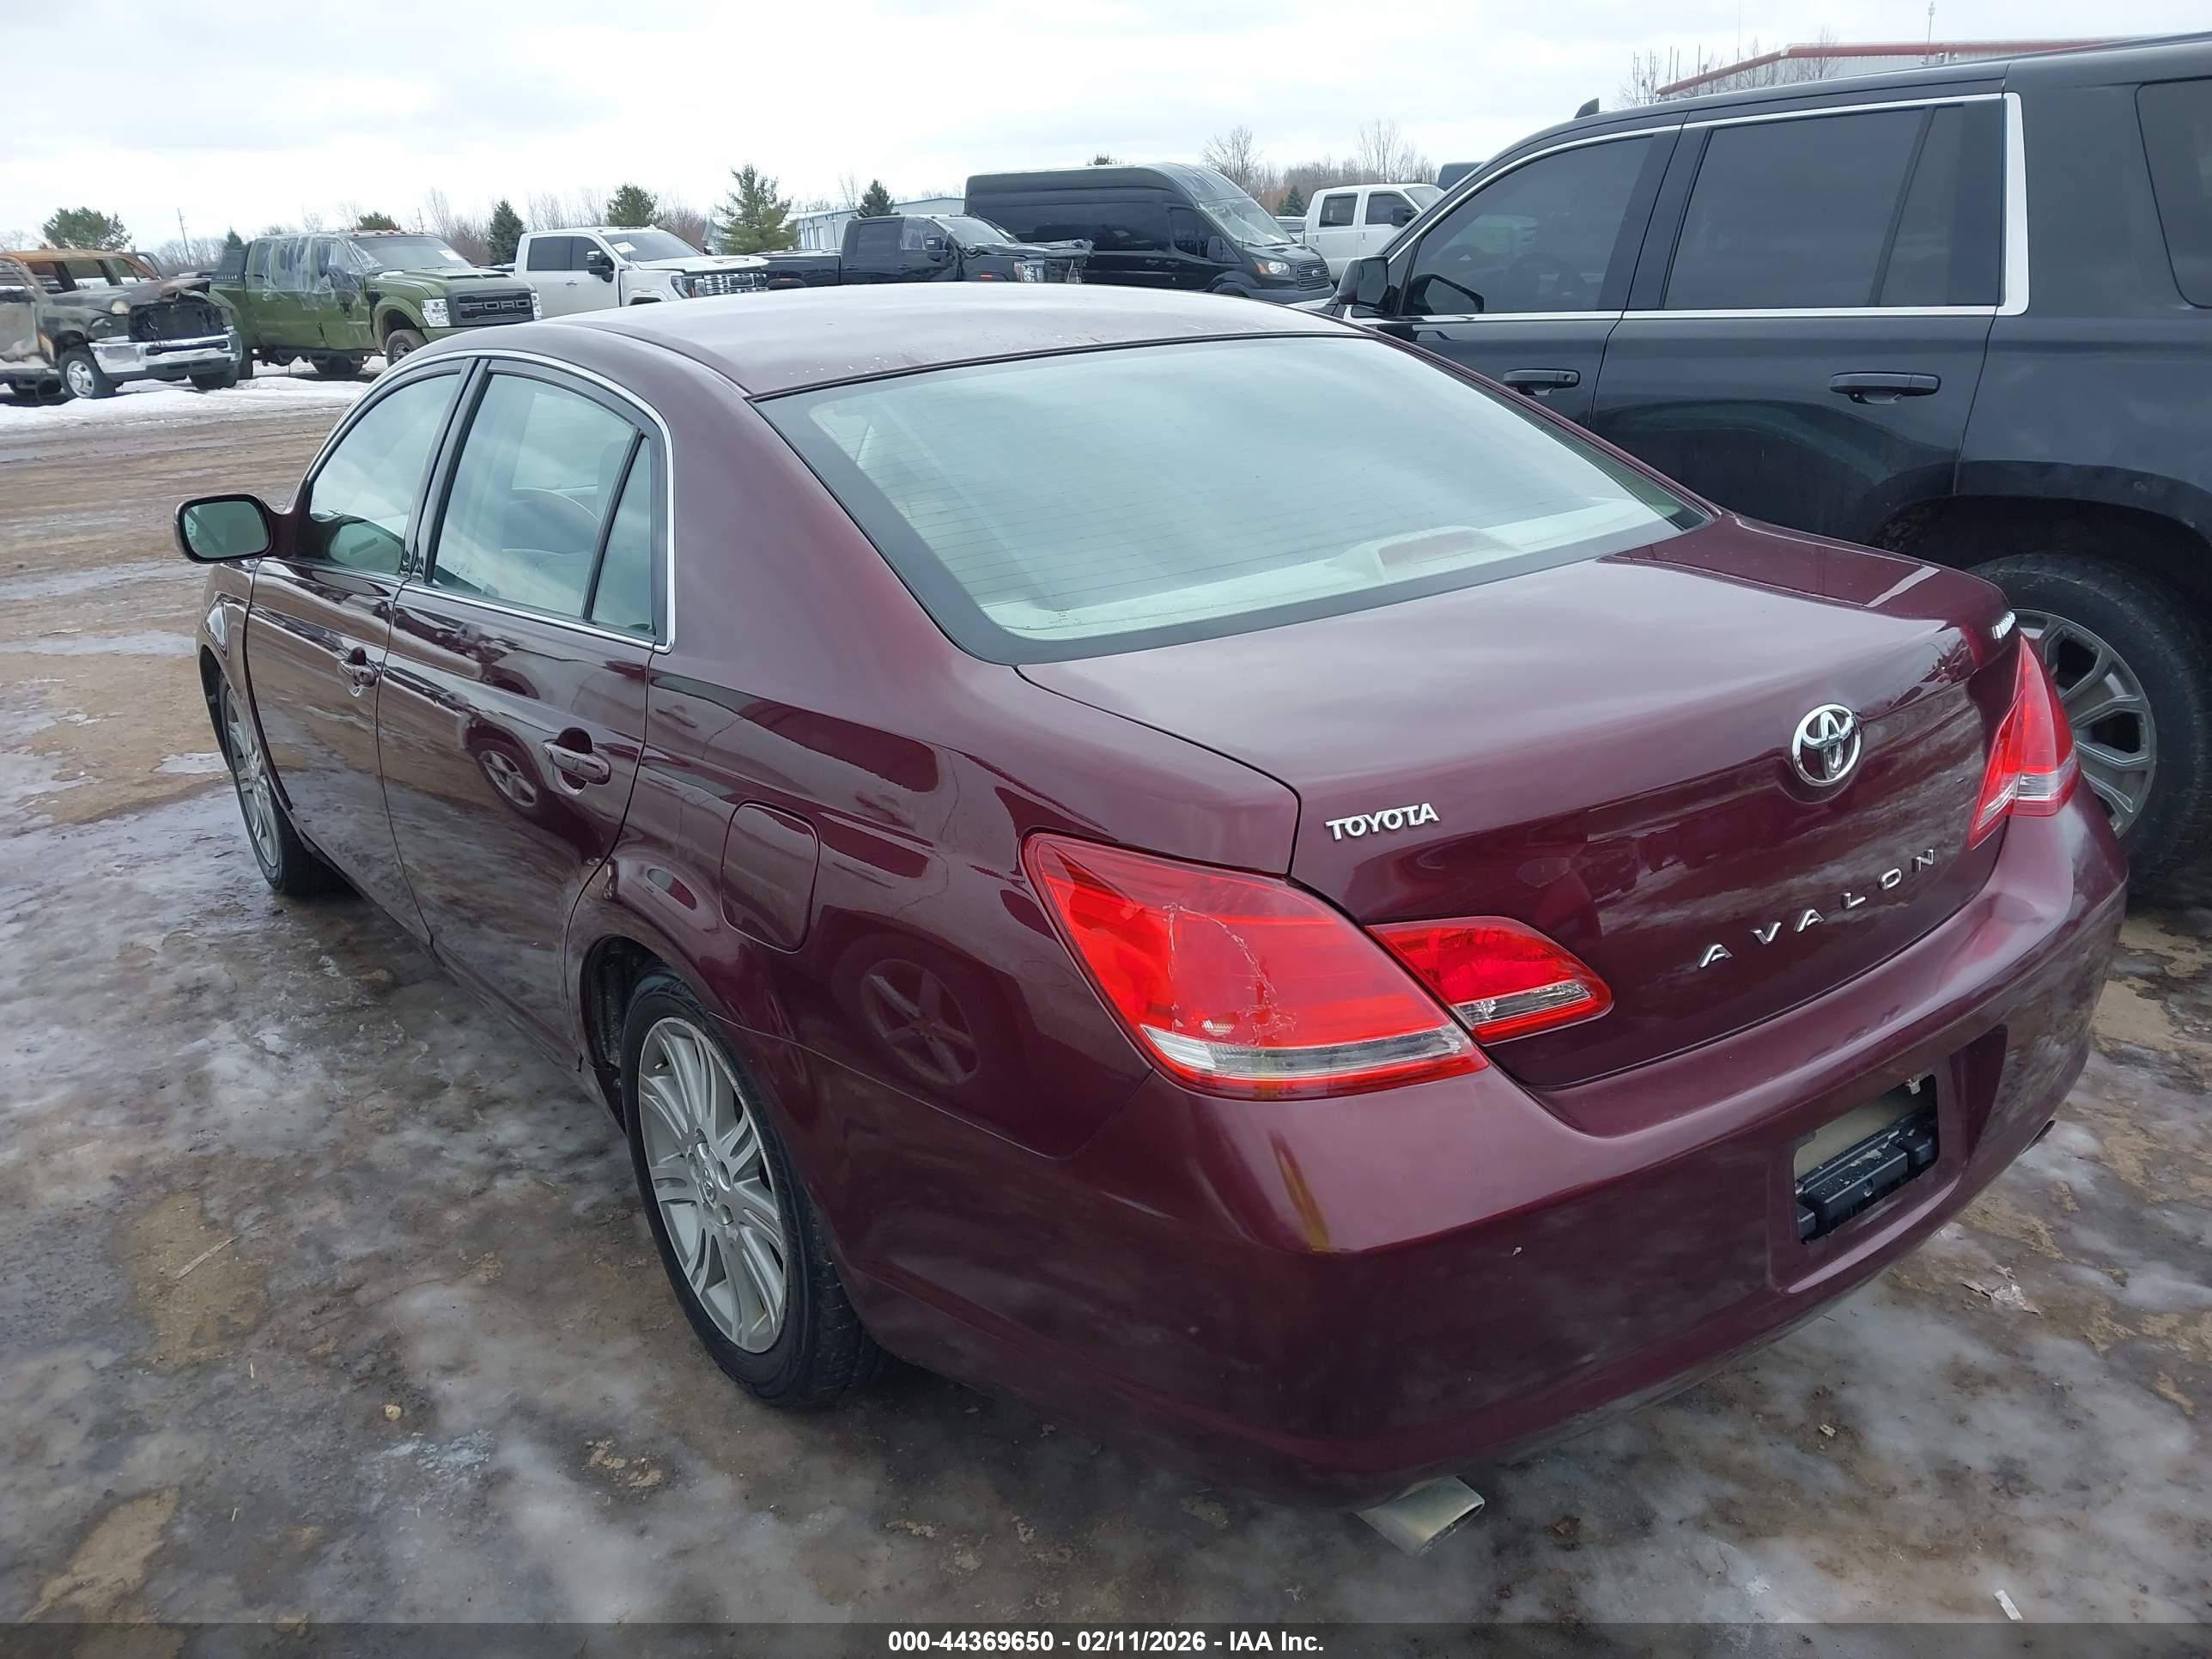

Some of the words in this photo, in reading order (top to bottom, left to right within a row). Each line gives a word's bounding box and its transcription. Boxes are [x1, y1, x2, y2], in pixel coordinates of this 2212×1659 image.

[466, 299, 531, 311] FORD
[1325, 802, 1440, 841] TOYOTA
[1697, 848, 1935, 969] AVALON
